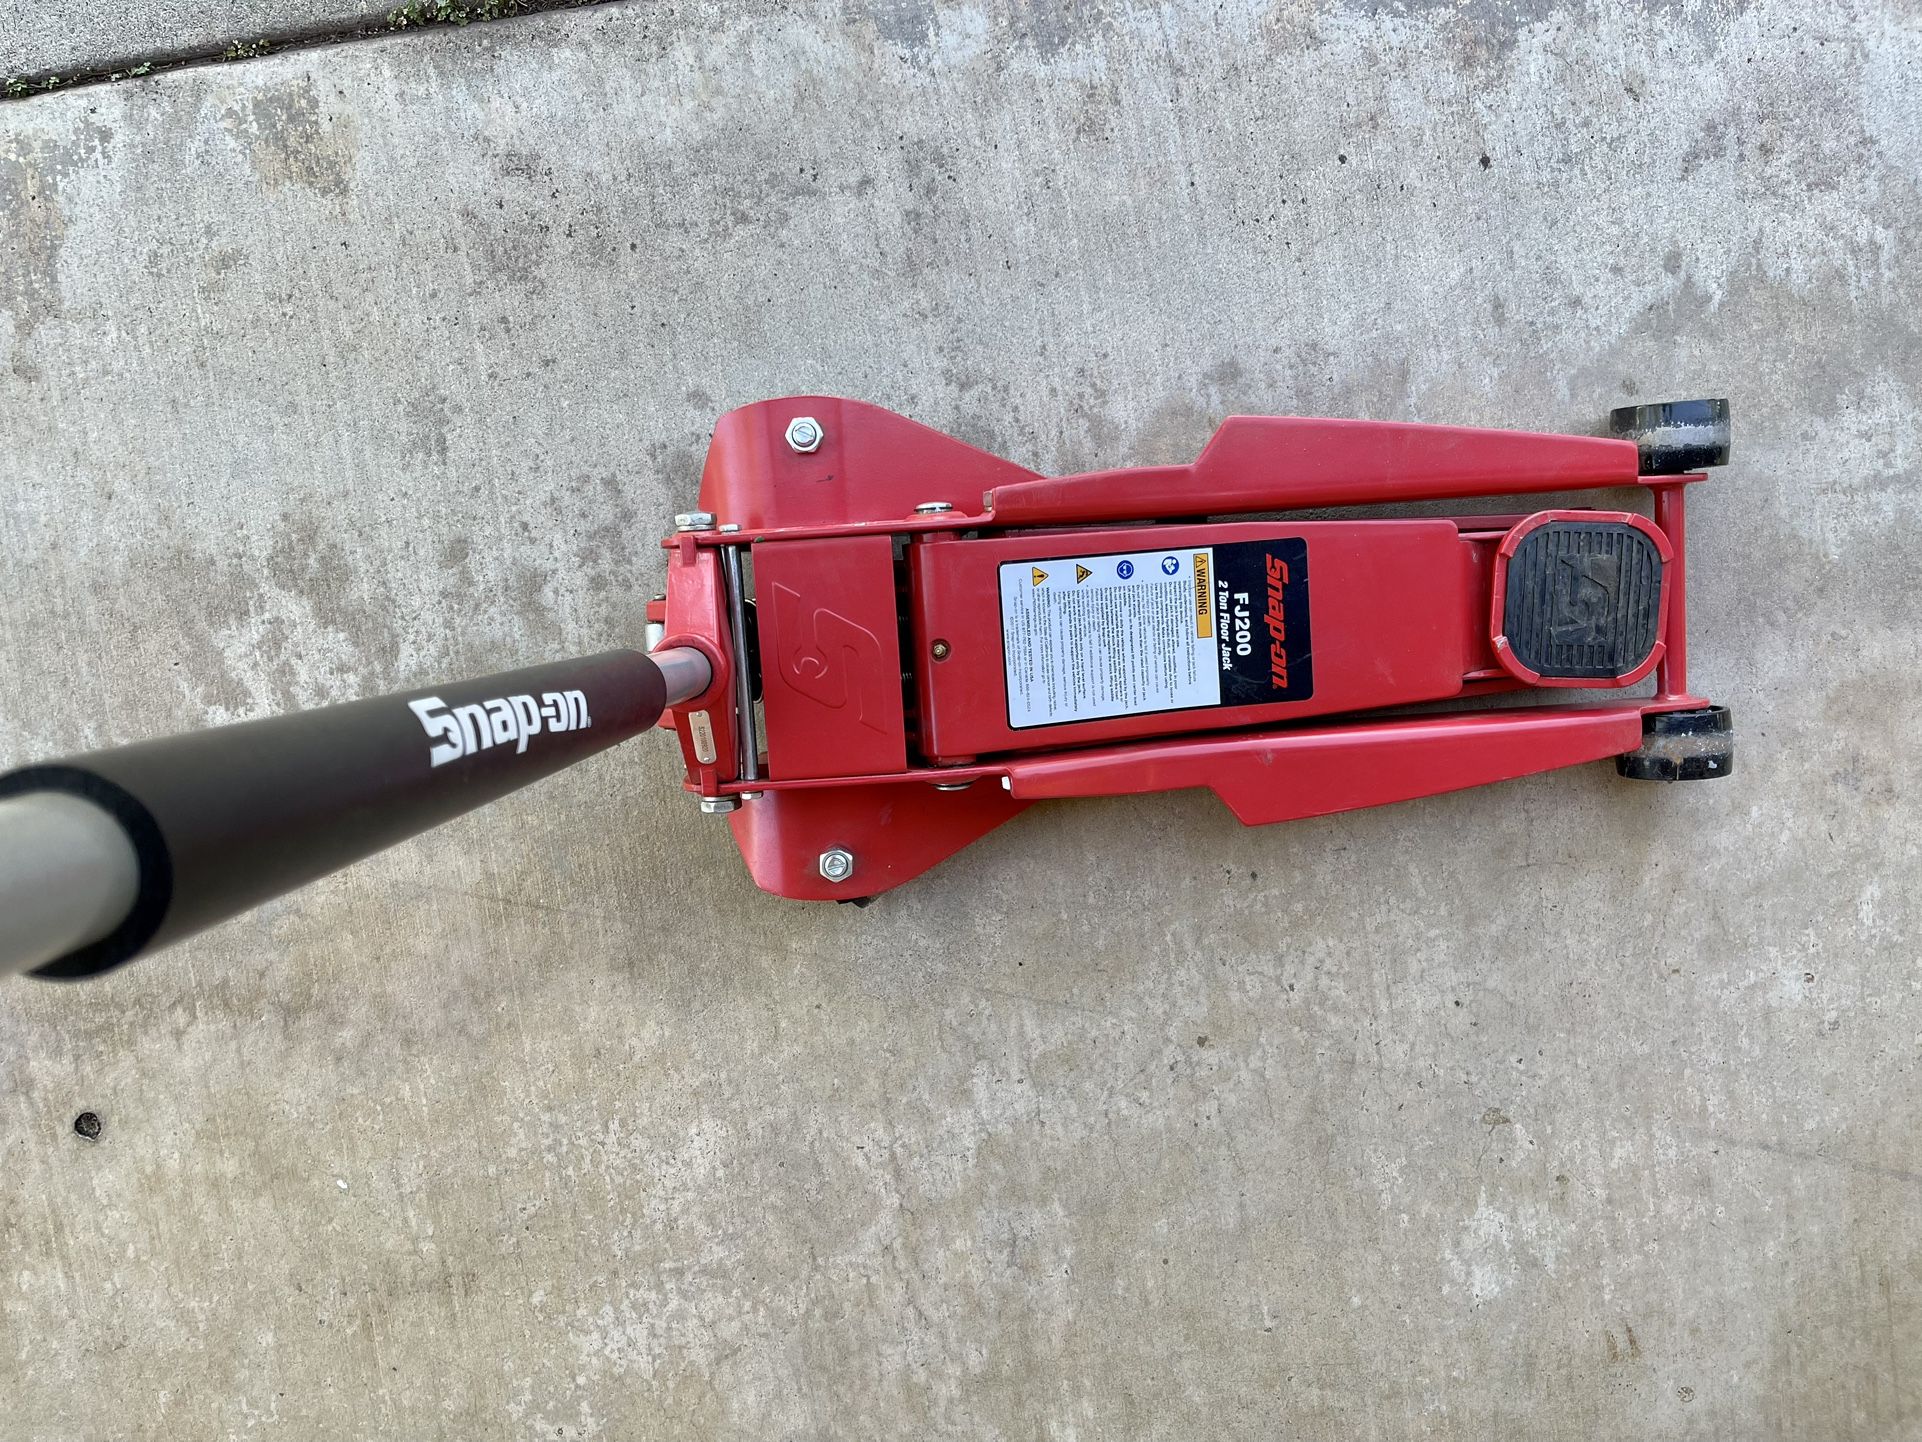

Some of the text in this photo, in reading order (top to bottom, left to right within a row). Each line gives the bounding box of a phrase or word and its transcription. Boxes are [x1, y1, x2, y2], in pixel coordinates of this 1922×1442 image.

[1196, 568, 1208, 615] WARNING
[1218, 580, 1232, 671] 2 Ton Floor Jack
[1234, 592, 1252, 656] FJ200
